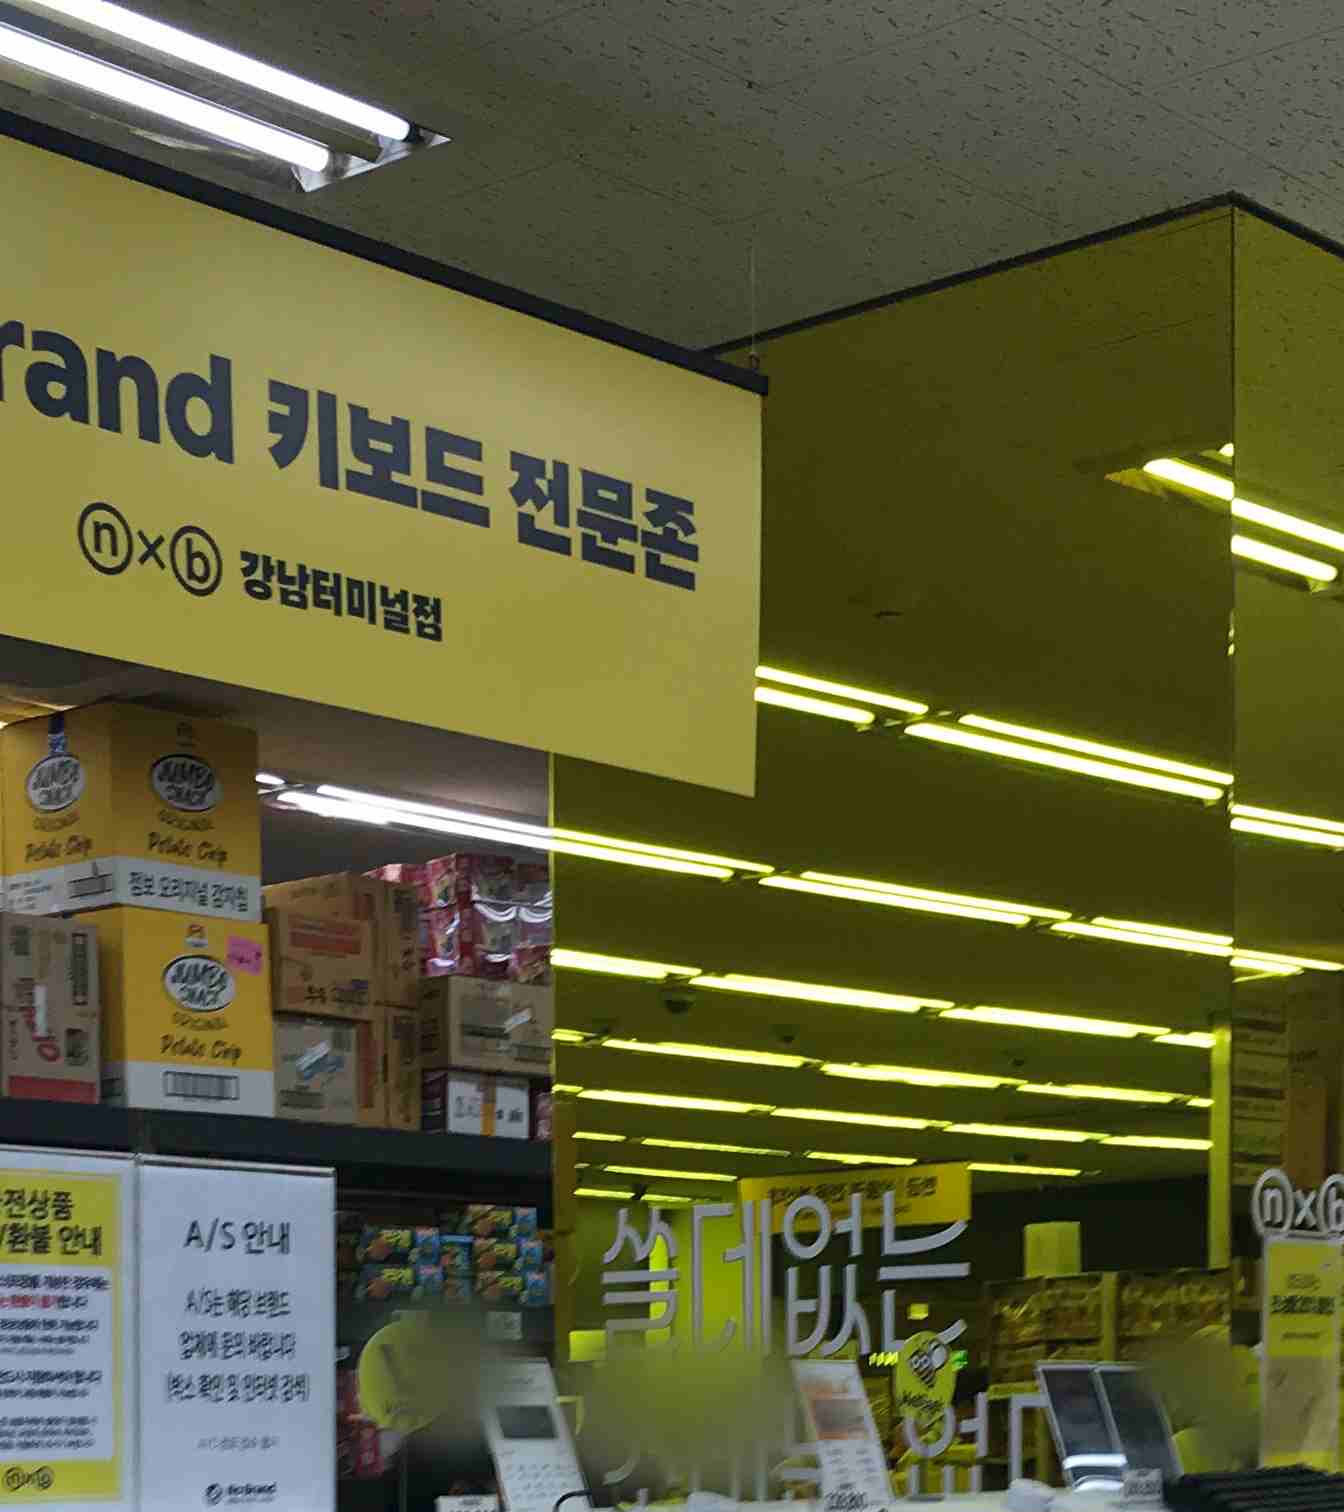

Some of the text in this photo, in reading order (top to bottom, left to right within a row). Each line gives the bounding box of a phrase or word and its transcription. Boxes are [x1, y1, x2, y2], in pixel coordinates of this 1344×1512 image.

[266, 380, 490, 530] 키보드
[508, 451, 699, 590] 전문존
[240, 547, 443, 643] 강남터미널점
[58, 1224, 104, 1257] 안내
[183, 1216, 291, 1255] A/S 안내
